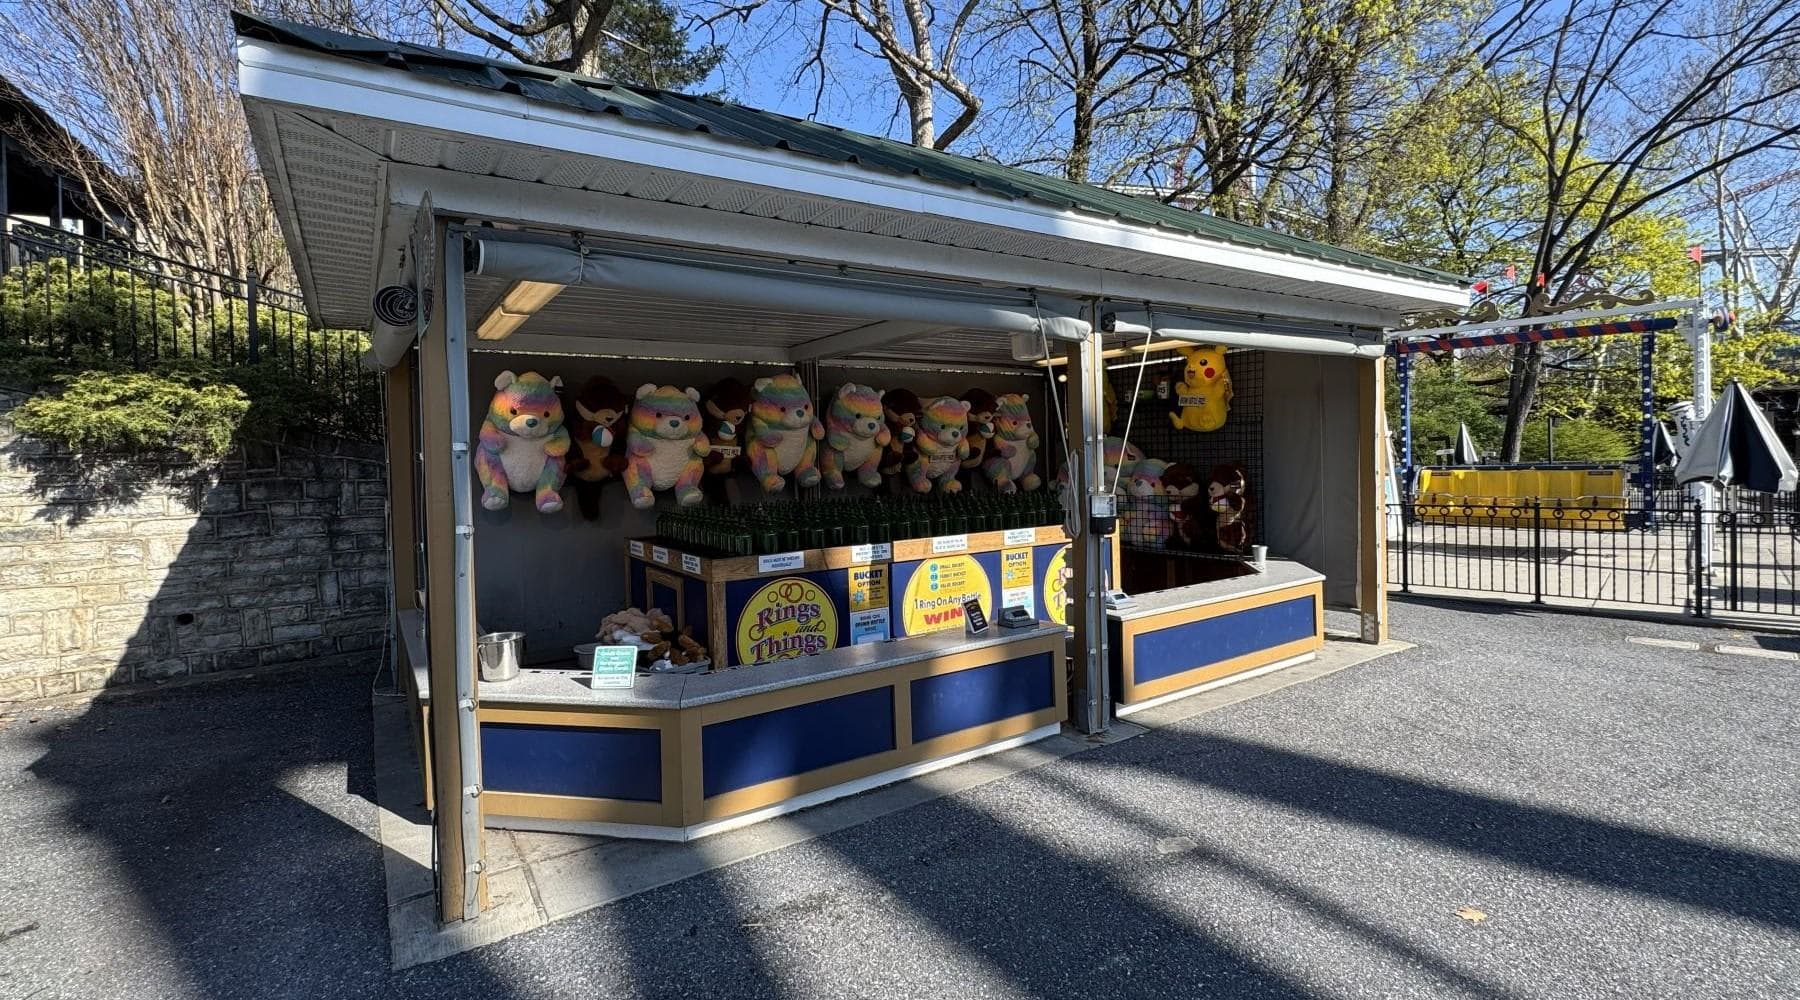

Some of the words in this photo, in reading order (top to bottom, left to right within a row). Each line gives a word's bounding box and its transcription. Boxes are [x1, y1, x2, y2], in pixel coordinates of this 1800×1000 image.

[1006, 552, 1028, 561] BUCKET
[854, 570, 883, 580] BUCKET
[857, 579, 881, 588] OPTION
[919, 600, 935, 609] Ring
[936, 597, 948, 606] On
[948, 595, 962, 605] Any
[756, 602, 821, 633] Rings
[795, 620, 826, 633] and
[750, 631, 827, 663] Things
